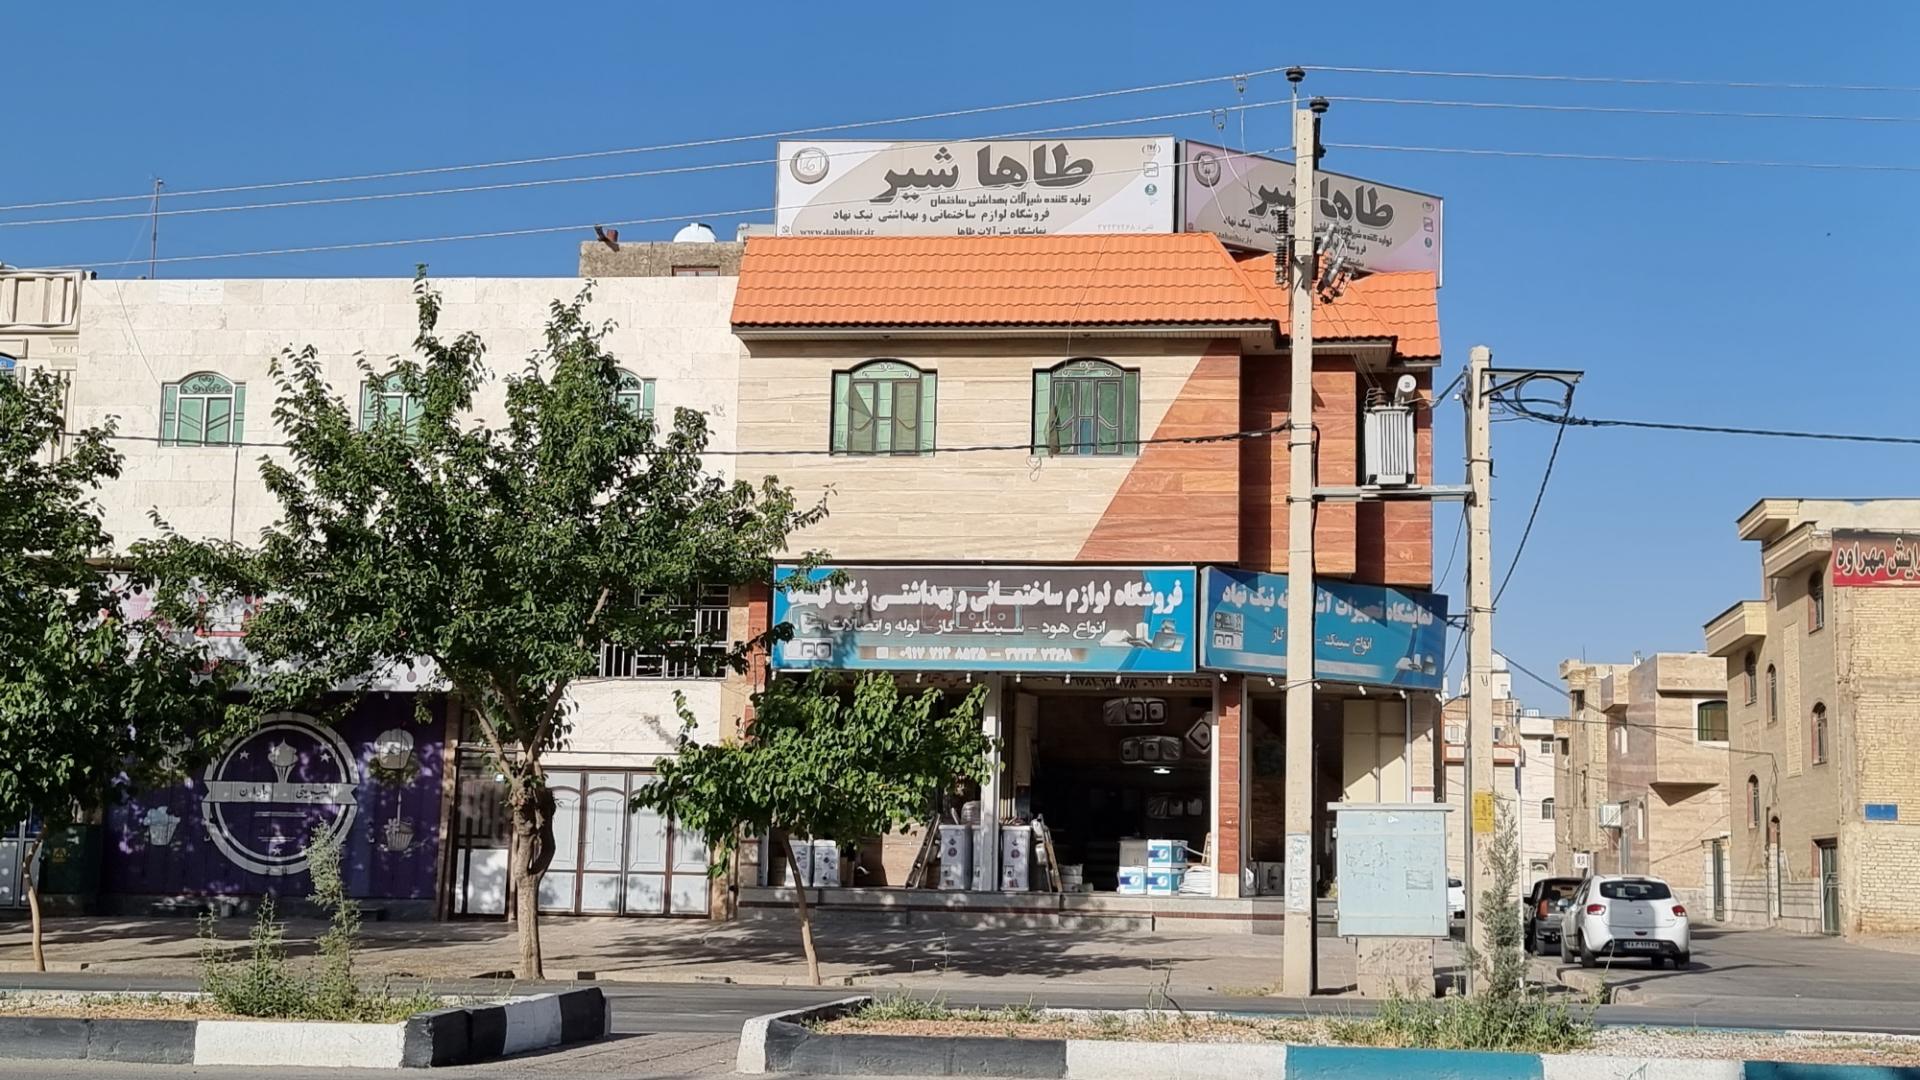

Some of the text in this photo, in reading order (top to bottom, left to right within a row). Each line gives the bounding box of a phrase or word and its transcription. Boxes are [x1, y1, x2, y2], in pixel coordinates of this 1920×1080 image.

[869, 142, 1094, 203] طاها شیر
[930, 195, 967, 208] ساختمان
[968, 194, 1008, 208] بهداشتی
[1044, 194, 1068, 205] کننده
[1069, 193, 1092, 207] تولید
[1319, 177, 1394, 227] طاها
[832, 208, 1050, 223] فروشگاه لوازم ساختمانی و بهداشتی نیک نهاد
[1836, 541, 1886, 577] مهراوه
[835, 579, 869, 608] نیک
[871, 579, 954, 612] بهداشتی
[956, 590, 967, 612] و
[969, 580, 1064, 613] ساختمانی
[1066, 580, 1112, 614] لوازم
[1114, 579, 1184, 614] فروشگاه
[1222, 581, 1247, 608] نهاد
[1249, 586, 1276, 612] نیک
[1386, 600, 1434, 629] نمایشگاه
[827, 618, 883, 633] اتصالات
[883, 622, 892, 636] و
[894, 618, 920, 638] لوله
[934, 618, 955, 636] گاز
[971, 619, 1025, 636] سینک
[1041, 621, 1071, 640] هود
[1072, 620, 1107, 640] انواع
[1352, 636, 1373, 656] انواع
